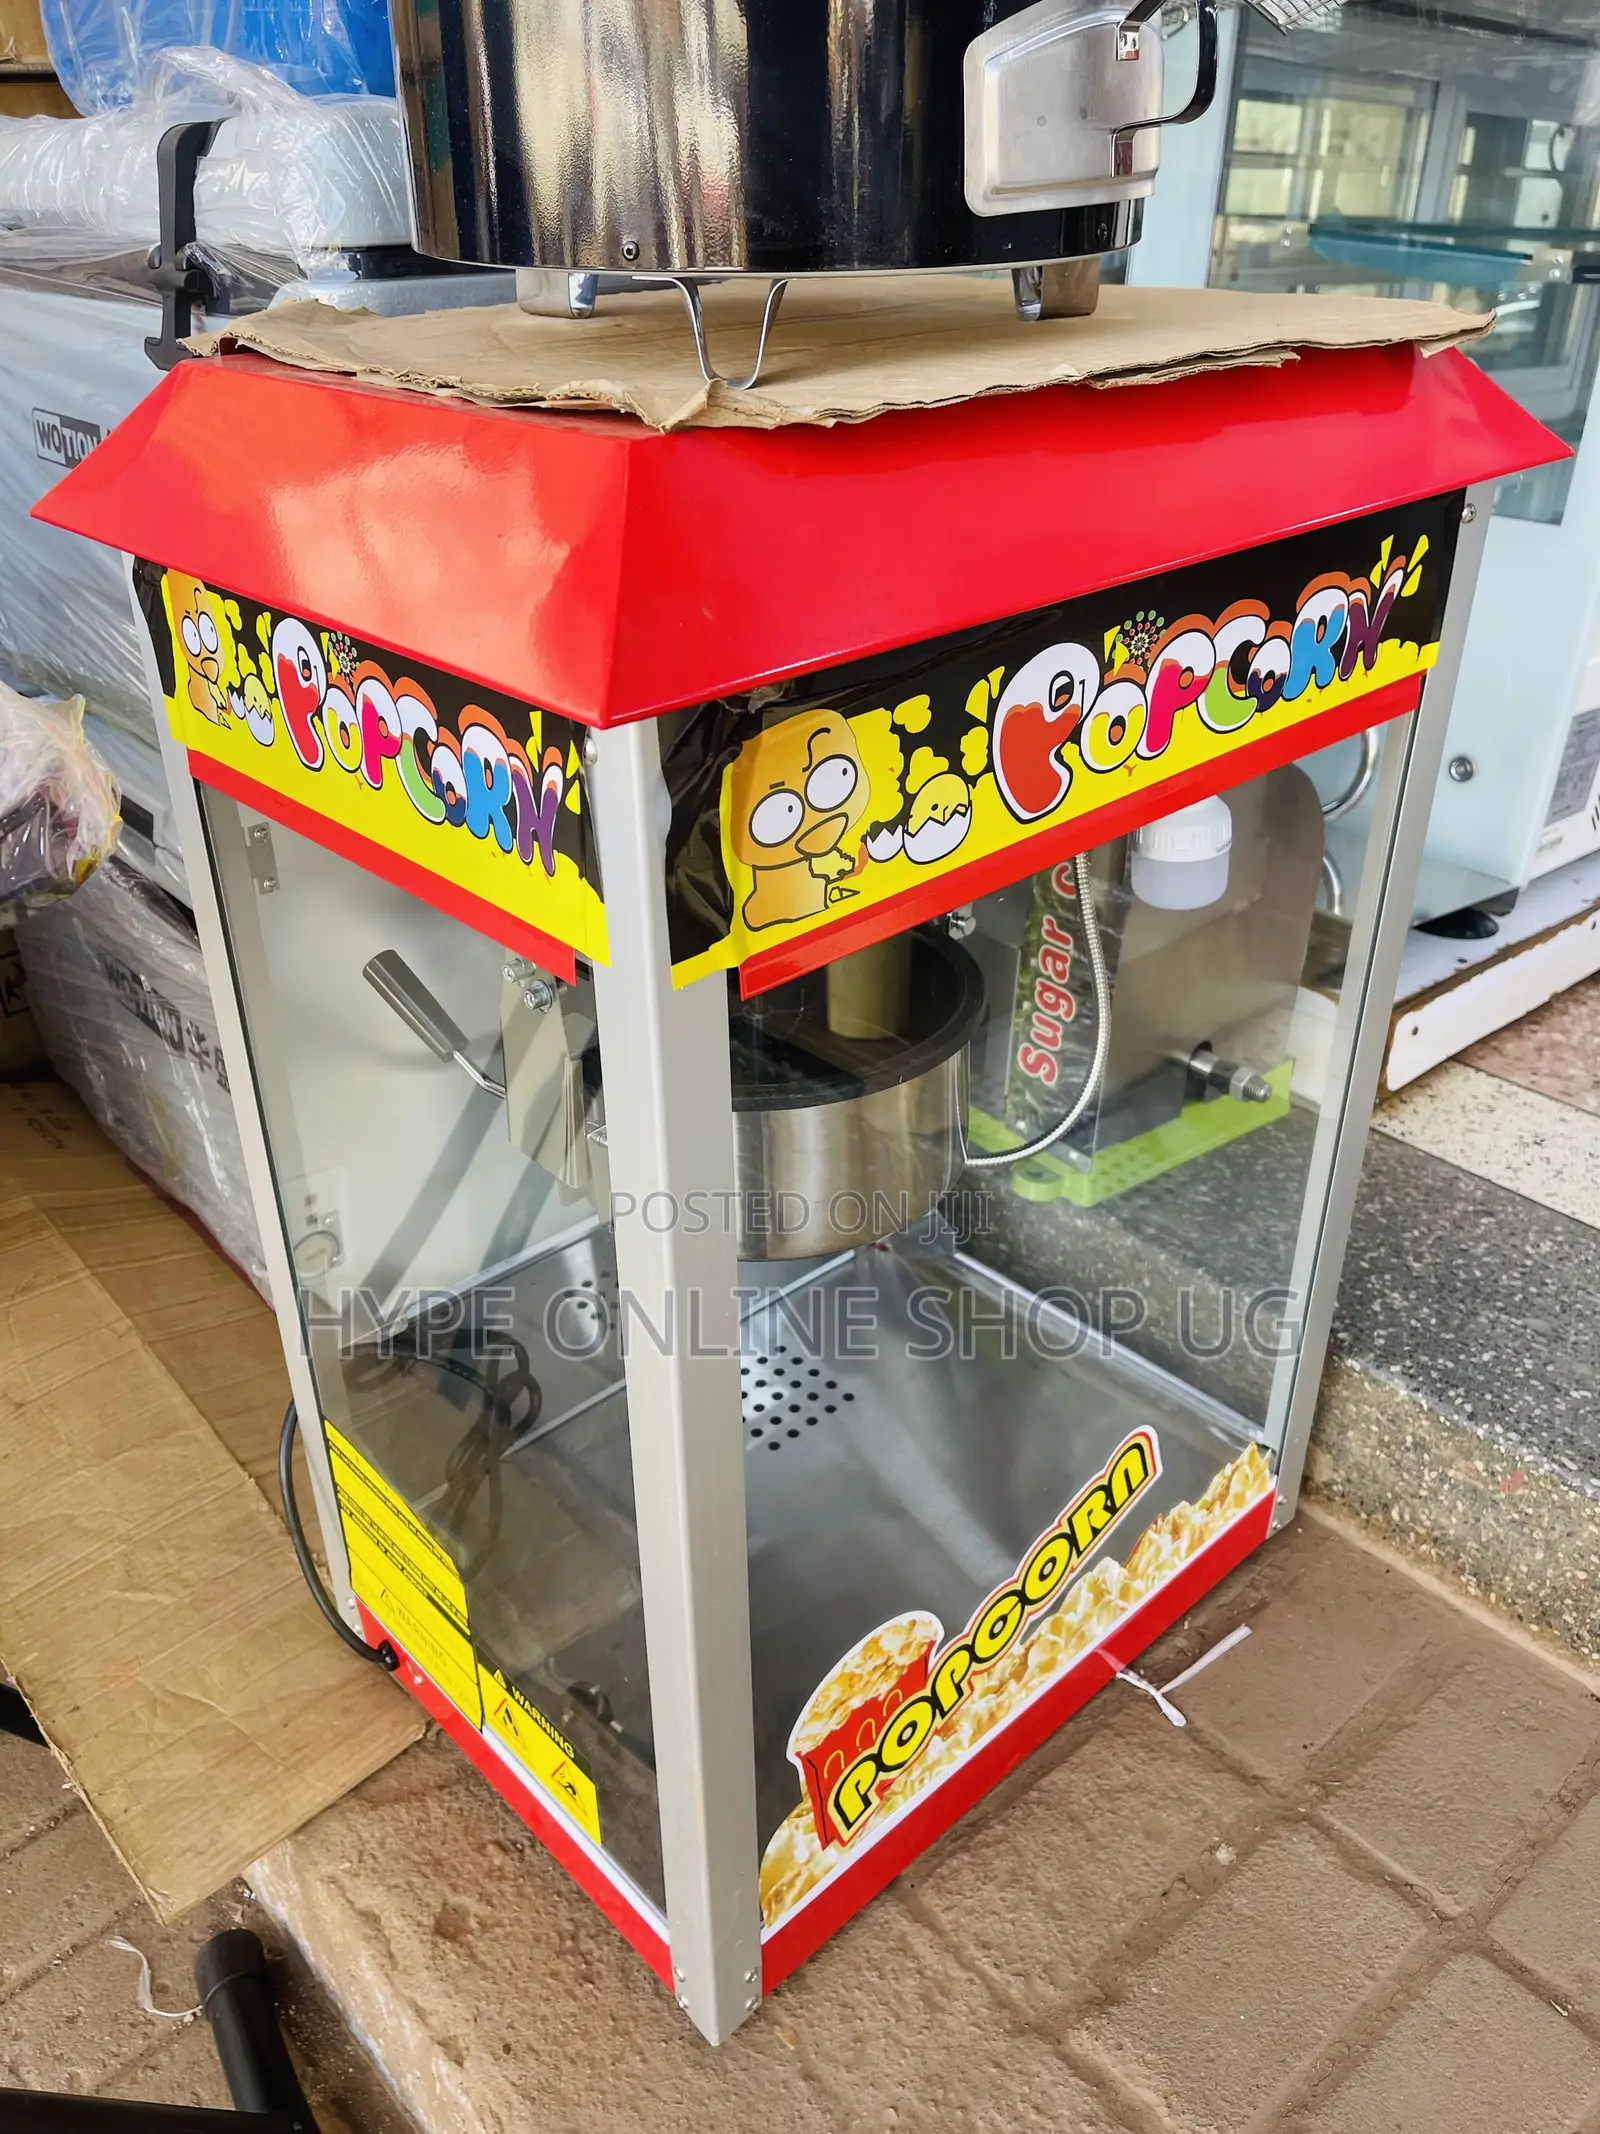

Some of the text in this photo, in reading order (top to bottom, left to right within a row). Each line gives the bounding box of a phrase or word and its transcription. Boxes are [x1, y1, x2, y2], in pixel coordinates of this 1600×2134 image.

[271, 616, 564, 878] POPCORN
[991, 554, 1407, 825] POPCORN
[1017, 914, 1075, 1086] Sugar
[511, 1685, 576, 1760] WARNING
